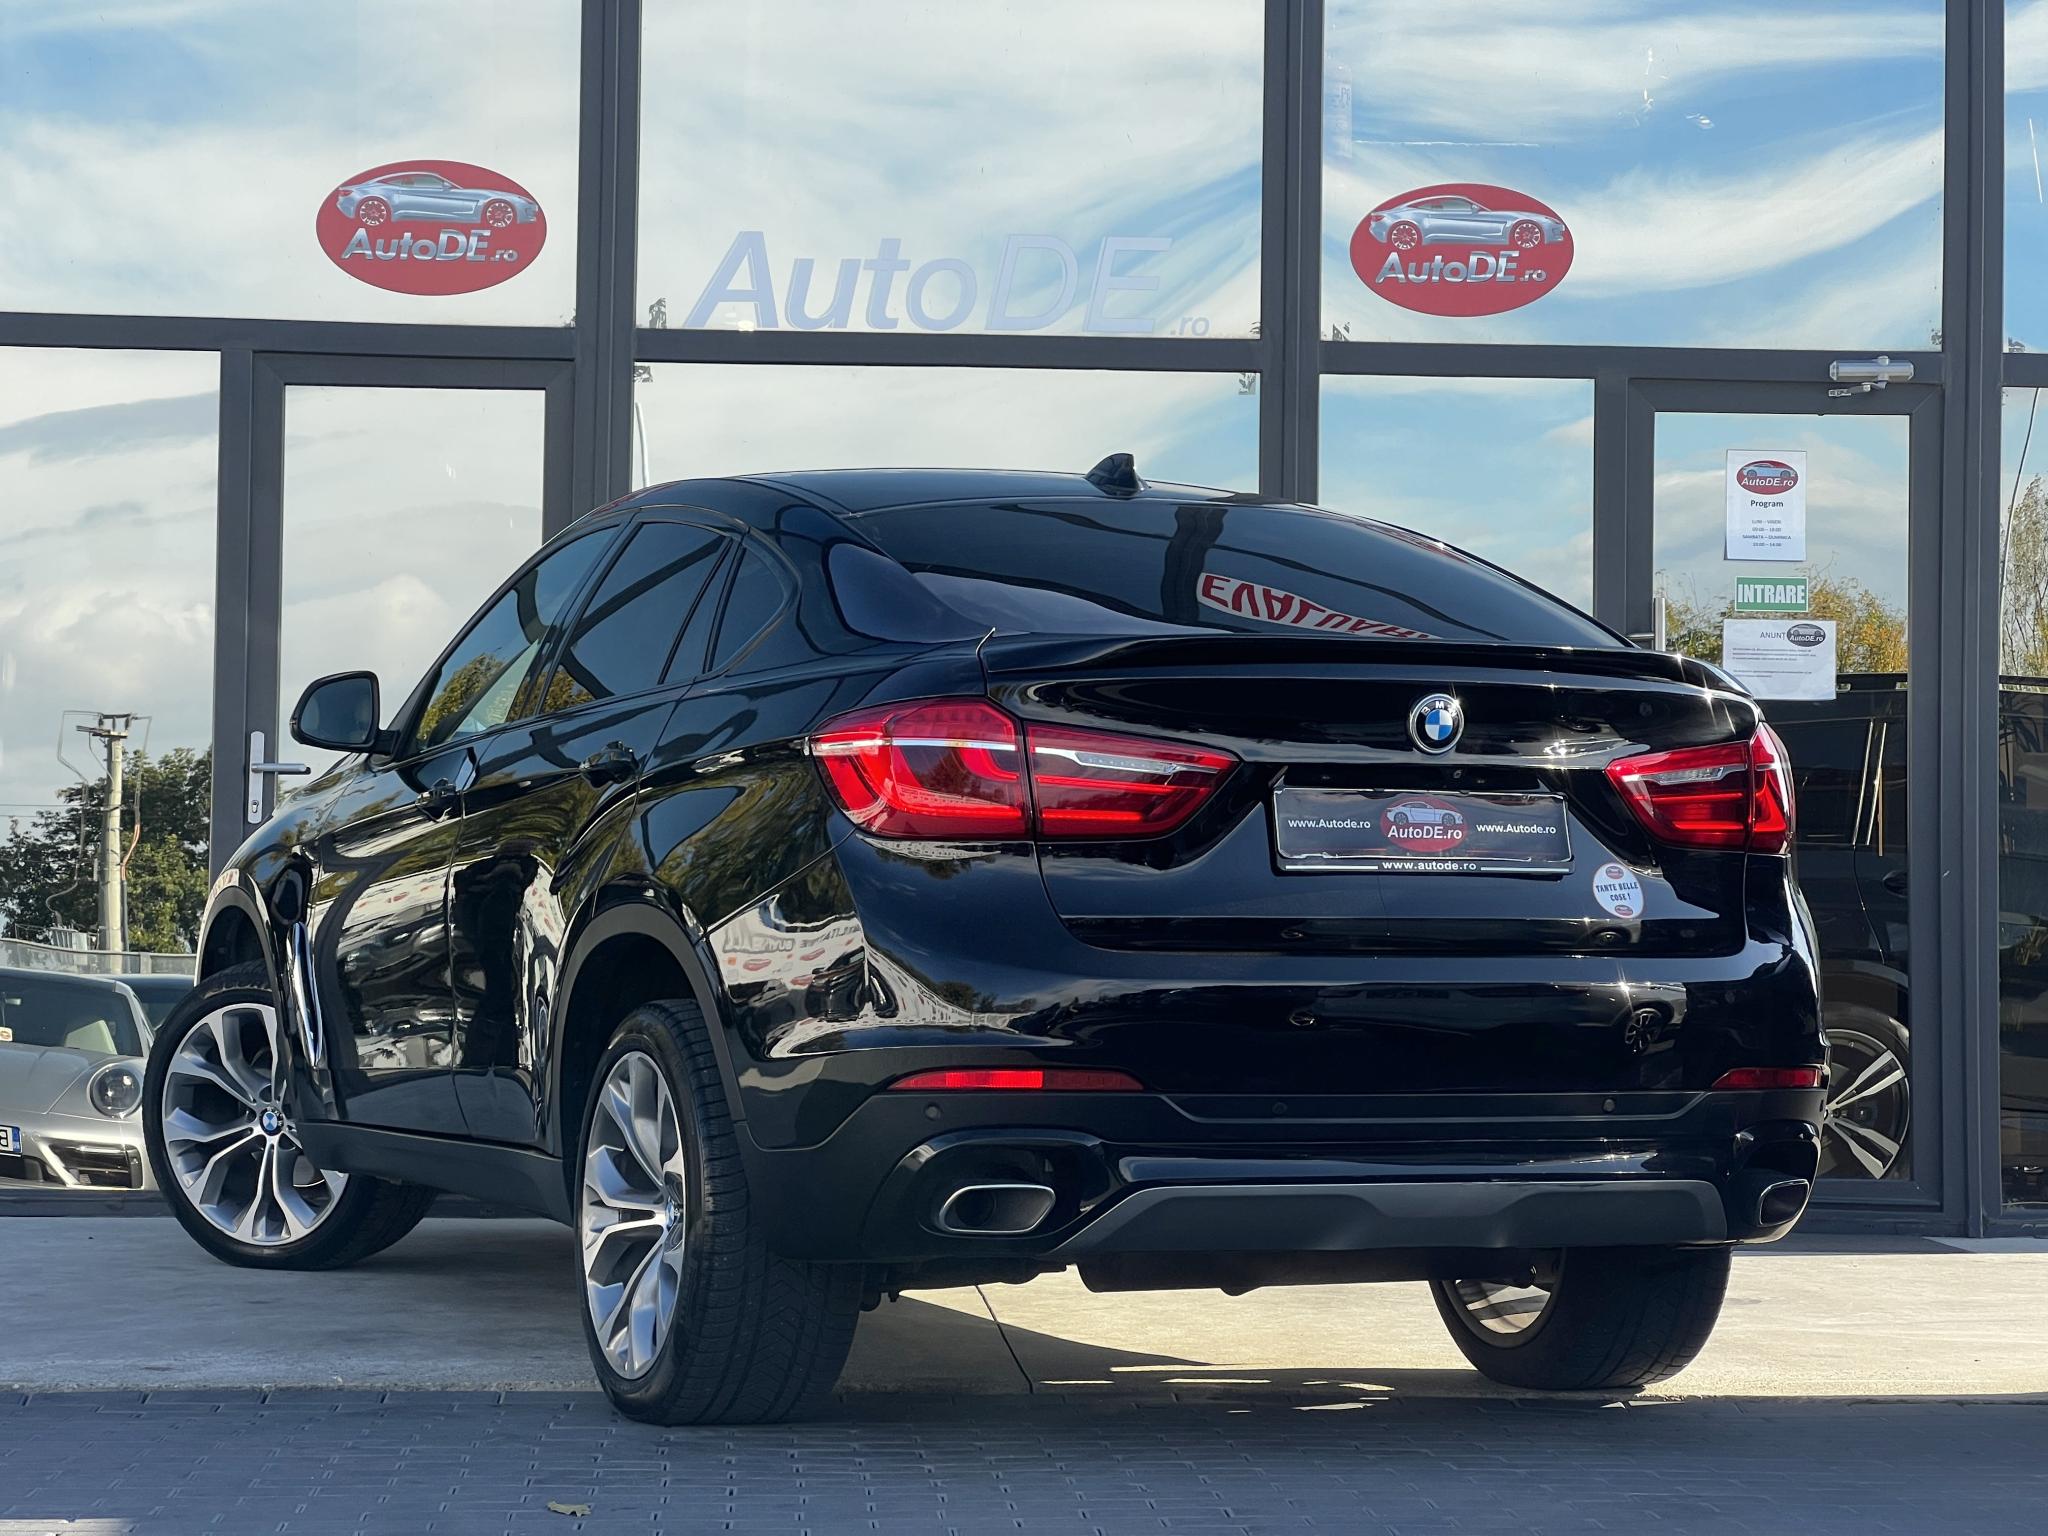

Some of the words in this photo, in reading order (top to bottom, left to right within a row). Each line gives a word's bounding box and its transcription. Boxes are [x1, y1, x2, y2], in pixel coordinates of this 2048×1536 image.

[341, 227, 518, 262] AutoDE.ro
[1376, 250, 1547, 284] AutoDE.ro
[682, 231, 1210, 336] AutoDE.ro
[1741, 477, 1794, 487] AutoDE.ro
[1750, 500, 1784, 509] Program
[1737, 584, 1806, 604] INTRARE
[1288, 819, 1371, 830] www.Autode.ro
[1476, 823, 1557, 835] www.Autode.ro
[1387, 826, 1463, 841] AutoDE.ro
[1382, 861, 1477, 871] www.autode.ro
[1595, 883, 1618, 893] TANTE
[1618, 881, 1639, 891] BELLE
[1610, 893, 1628, 902] COSE
